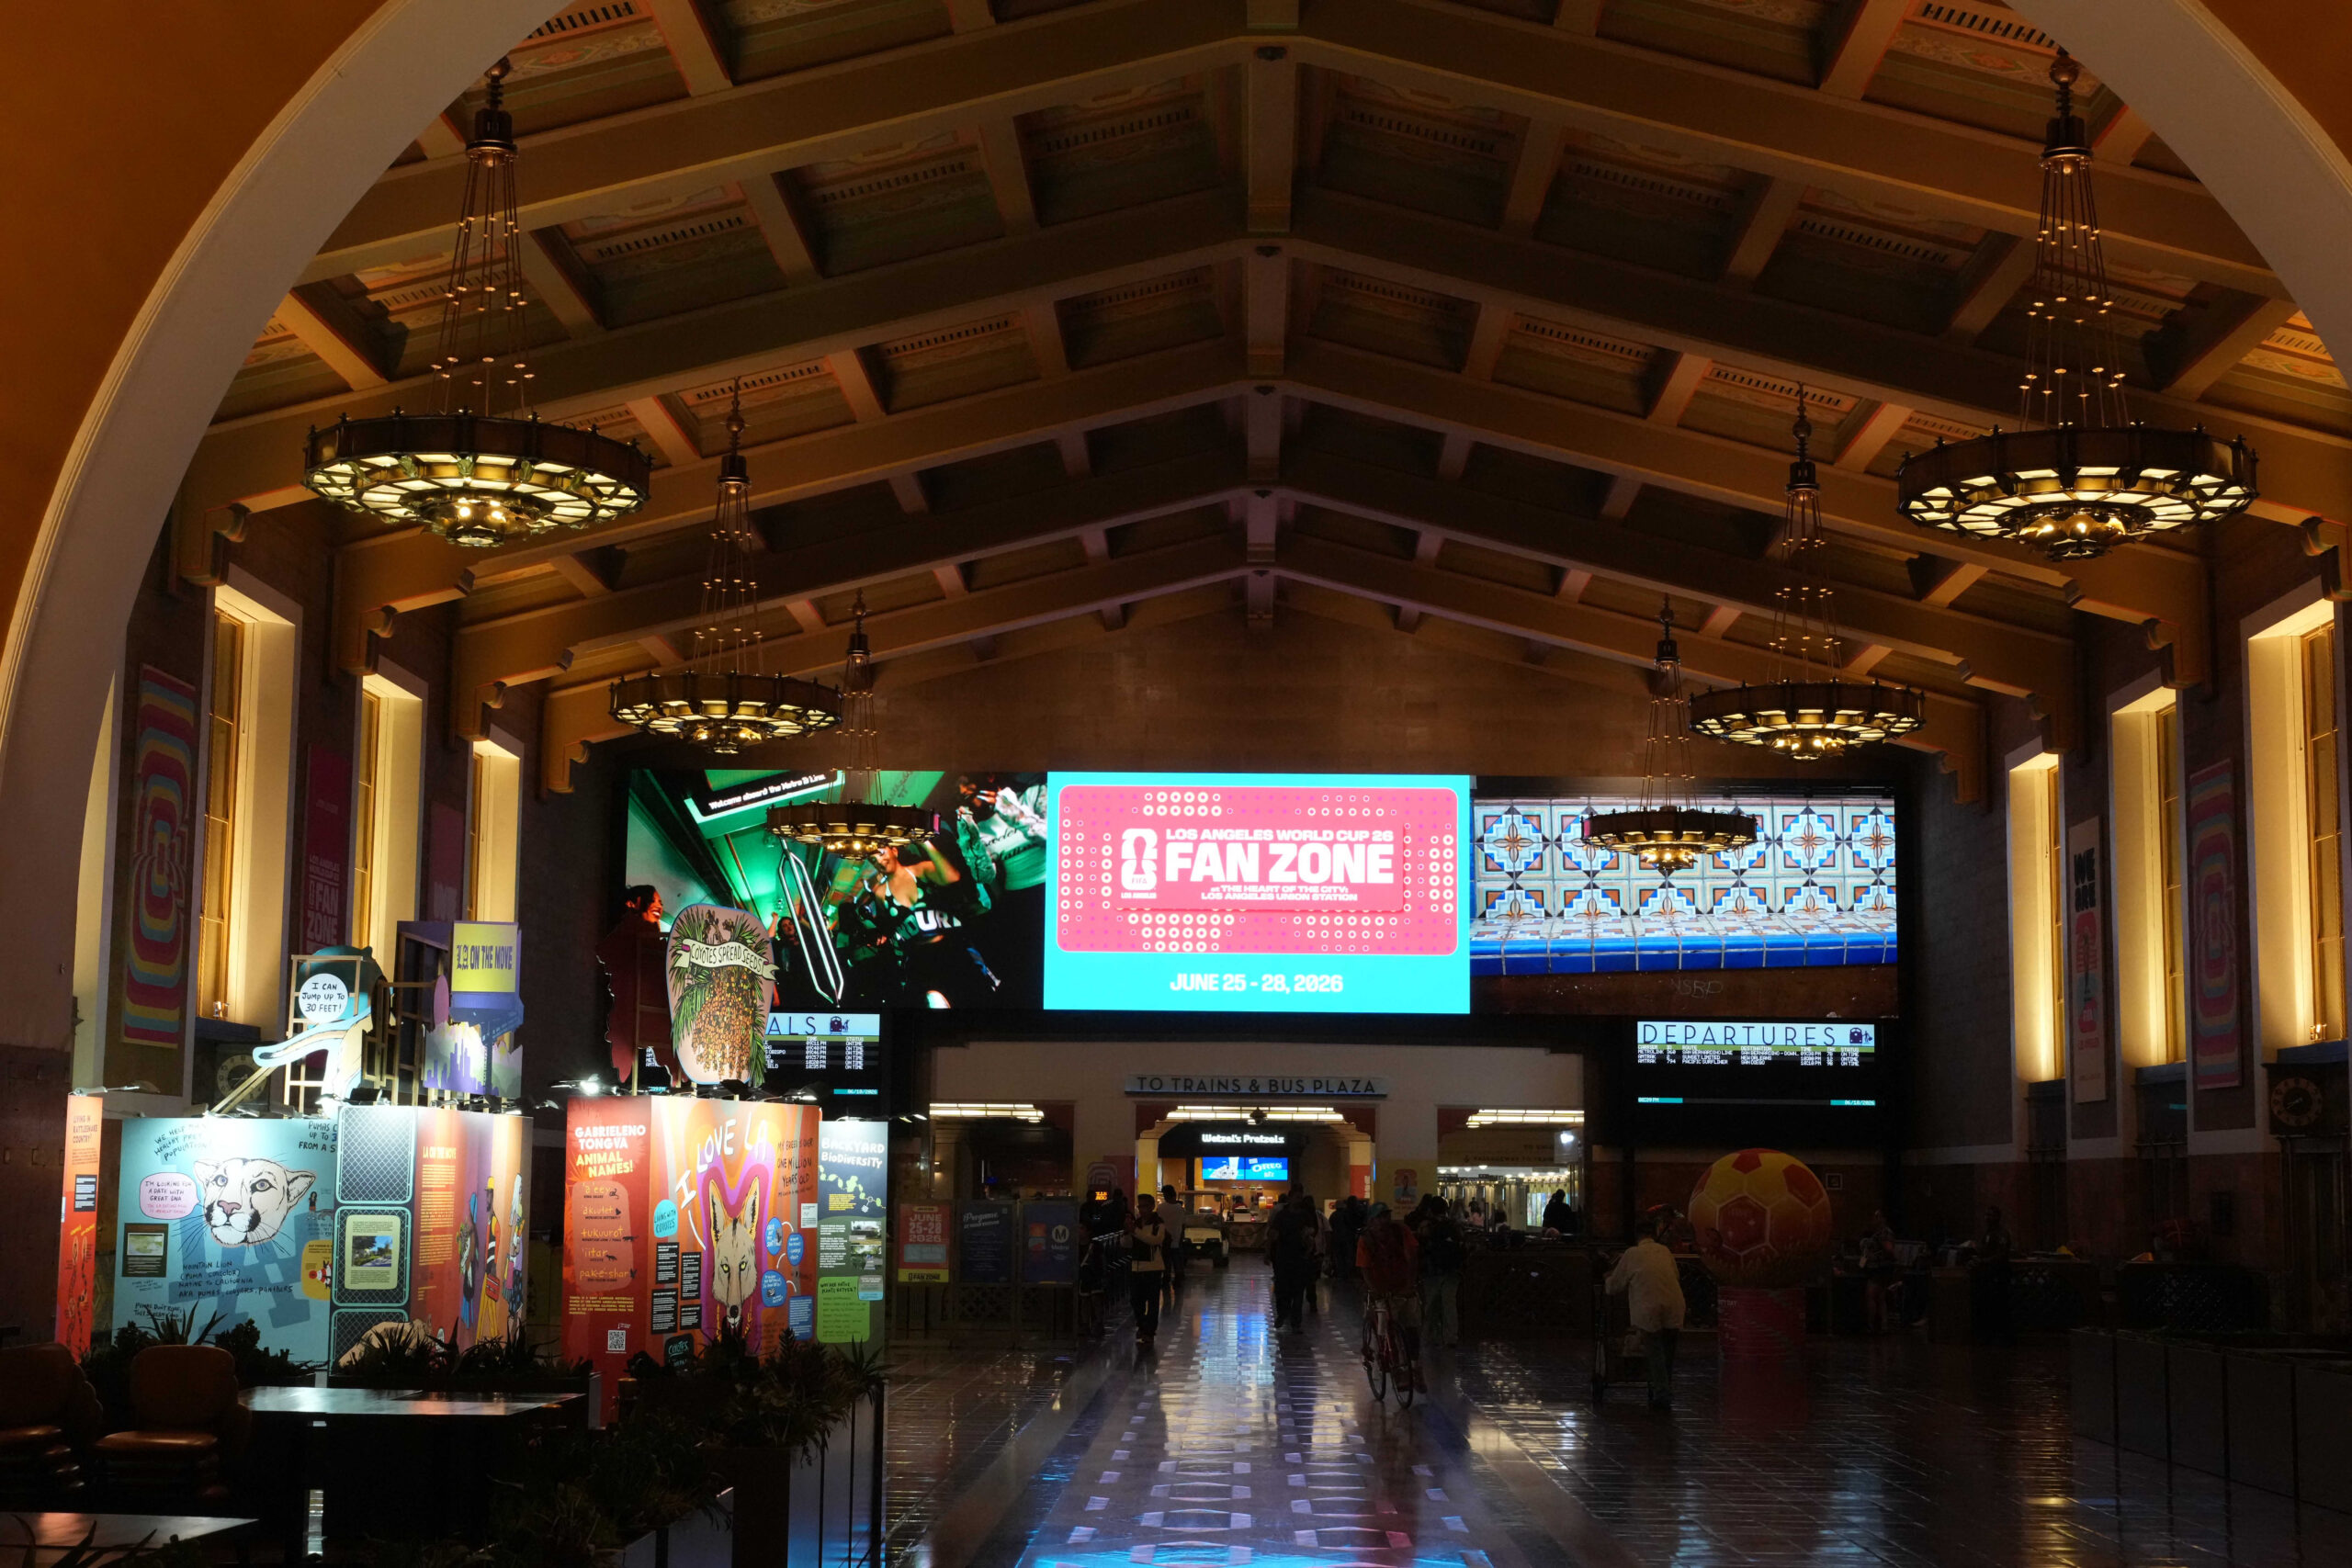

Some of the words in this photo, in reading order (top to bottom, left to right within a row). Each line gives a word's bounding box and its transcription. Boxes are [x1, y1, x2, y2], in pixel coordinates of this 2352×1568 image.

[708, 795, 741, 809] Welcome
[743, 788, 768, 801] aboard
[781, 779, 802, 790] Metro
[1165, 829, 1198, 840] LOS
[1201, 829, 1273, 841] ANGELES
[1276, 829, 1333, 841] WORLD
[1337, 830, 1368, 842] CUP
[1371, 830, 1393, 842] 26
[1165, 842, 1258, 882] FAN
[1268, 843, 1394, 884] ZONE
[2074, 847, 2095, 886] WE
[315, 881, 339, 916] FAN
[2075, 882, 2096, 912] ARE
[308, 909, 338, 945] ZONE
[470, 945, 480, 969] ON
[481, 945, 493, 969] THE
[494, 945, 513, 970] MOVE
[691, 943, 717, 964] COYOTES
[718, 944, 741, 963] SPREAD
[1170, 974, 1218, 990] JUNE
[1223, 974, 1246, 991] 25
[1262, 974, 1290, 993] 28,
[1294, 975, 1342, 991] 2026
[305, 1003, 316, 1011] 30
[1643, 1024, 1835, 1046] DEPARTURES
[1136, 1077, 1163, 1090] TO
[1171, 1077, 1241, 1092] TRAINS
[1249, 1078, 1260, 1092] &
[1269, 1078, 1305, 1093] BUS
[1313, 1079, 1375, 1094] PLAZA
[309, 1121, 330, 1132] PUMAS
[575, 1124, 647, 1138] GABRIELENO
[154, 1134, 166, 1145] WE
[169, 1125, 186, 1135] HELP
[321, 1132, 329, 1141] TO
[697, 1119, 736, 1173] LOVE
[744, 1111, 768, 1161] LA
[1202, 1134, 1242, 1143] Wetzel's
[1243, 1134, 1285, 1144] Pretzels
[154, 1135, 179, 1156] HEALTHY
[299, 1141, 319, 1150] FROM
[579, 1137, 628, 1150] TONGVA
[821, 1137, 885, 1154] BACKYARD
[576, 1151, 624, 1167] ANIMAL
[777, 1158, 786, 1168] ONE
[788, 1156, 812, 1169] MILLION
[1252, 1162, 1283, 1172] OREO
[588, 1159, 634, 1178] NAMES!
[782, 1173, 797, 1188] YEARS
[799, 1173, 809, 1185] OLD
[675, 1169, 696, 1209] I
[910, 1213, 942, 1222] JUNE
[909, 1222, 942, 1235] 25-28
[1055, 1228, 1066, 1240] M
[183, 1261, 212, 1270] MOUNTAIN
[215, 1278, 254, 1286] CALIFORNIA
